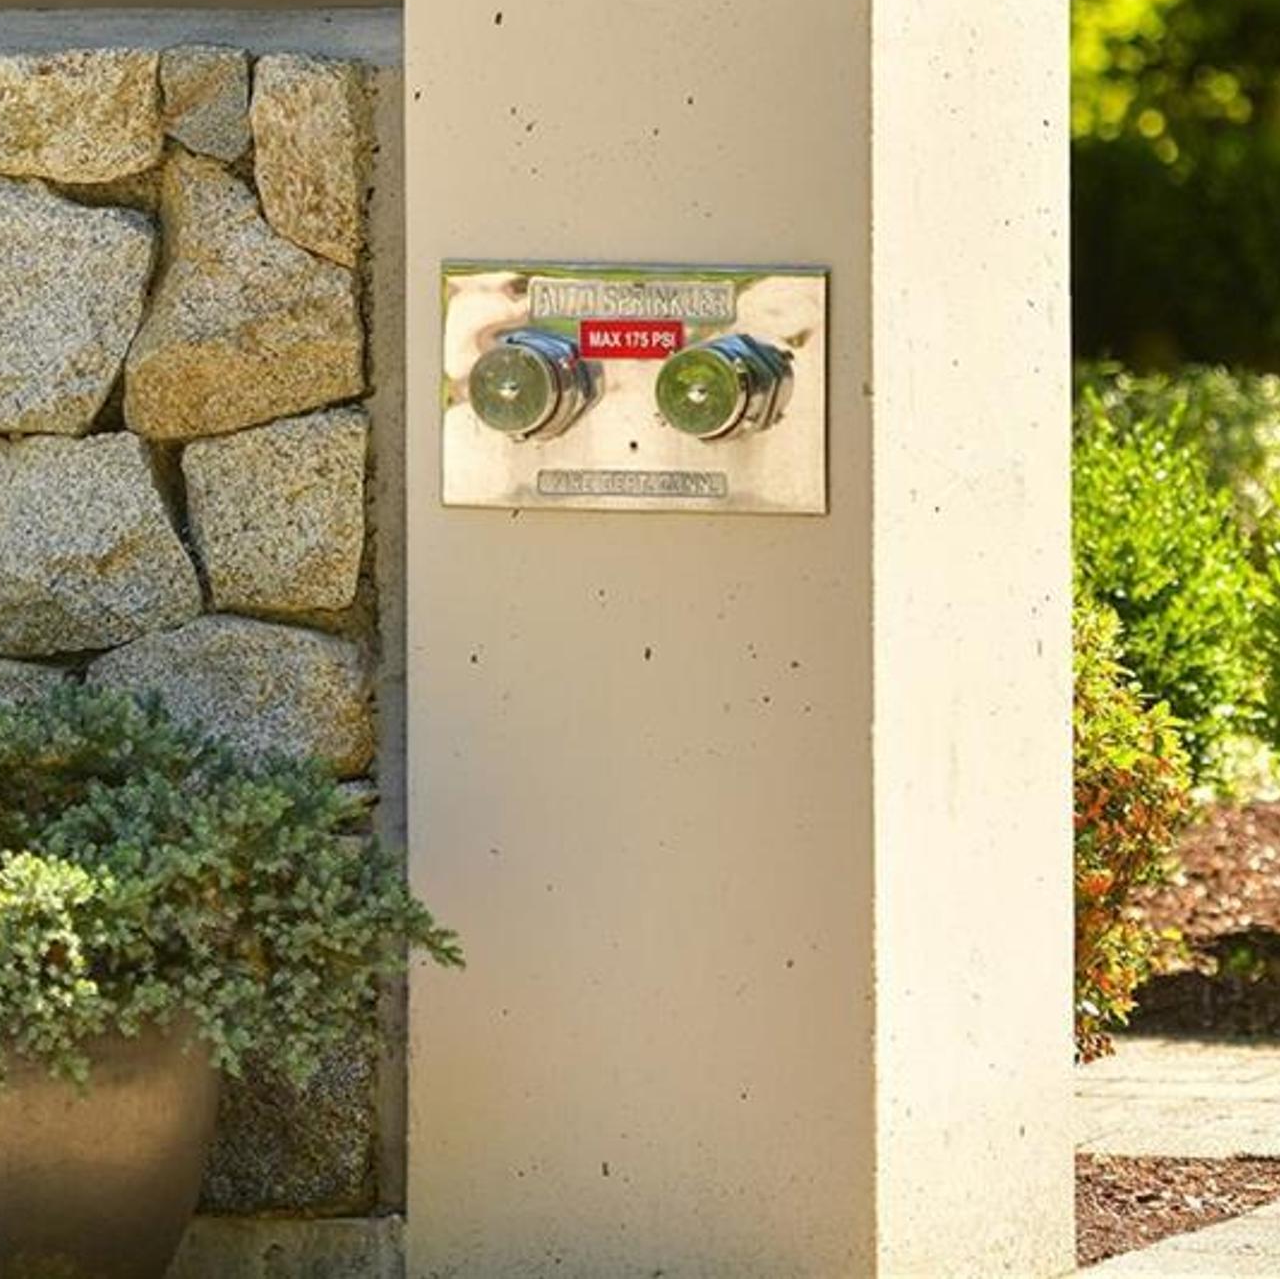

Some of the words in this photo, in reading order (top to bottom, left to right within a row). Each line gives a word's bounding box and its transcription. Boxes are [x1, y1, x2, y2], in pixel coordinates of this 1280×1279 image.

[588, 332, 622, 348] MAX
[625, 332, 648, 348] 175
[652, 333, 677, 348] PSI
